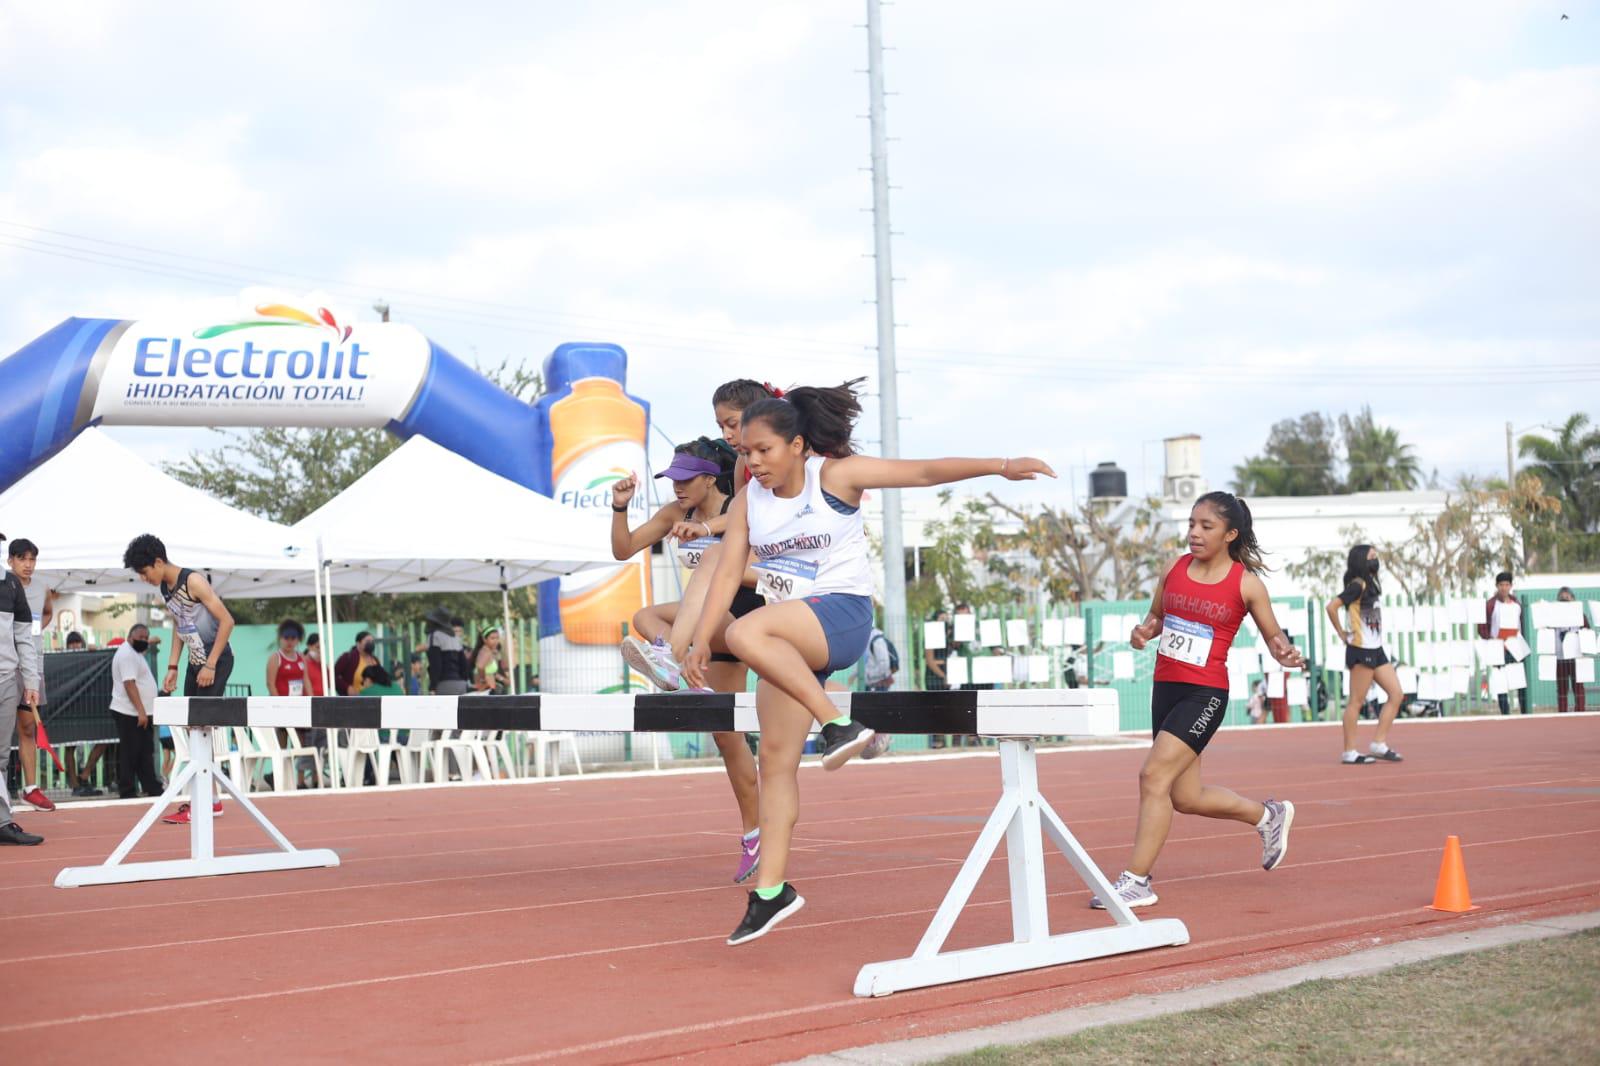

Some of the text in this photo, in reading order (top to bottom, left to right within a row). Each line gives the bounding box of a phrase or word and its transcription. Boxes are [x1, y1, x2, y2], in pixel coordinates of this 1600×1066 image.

[133, 337, 369, 380] Electrolit
[127, 382, 364, 400] ¡HIDRATACIÓN TOTAL!
[561, 490, 645, 510] Electlit
[767, 573, 793, 594] 290
[1168, 633, 1193, 653] 291
